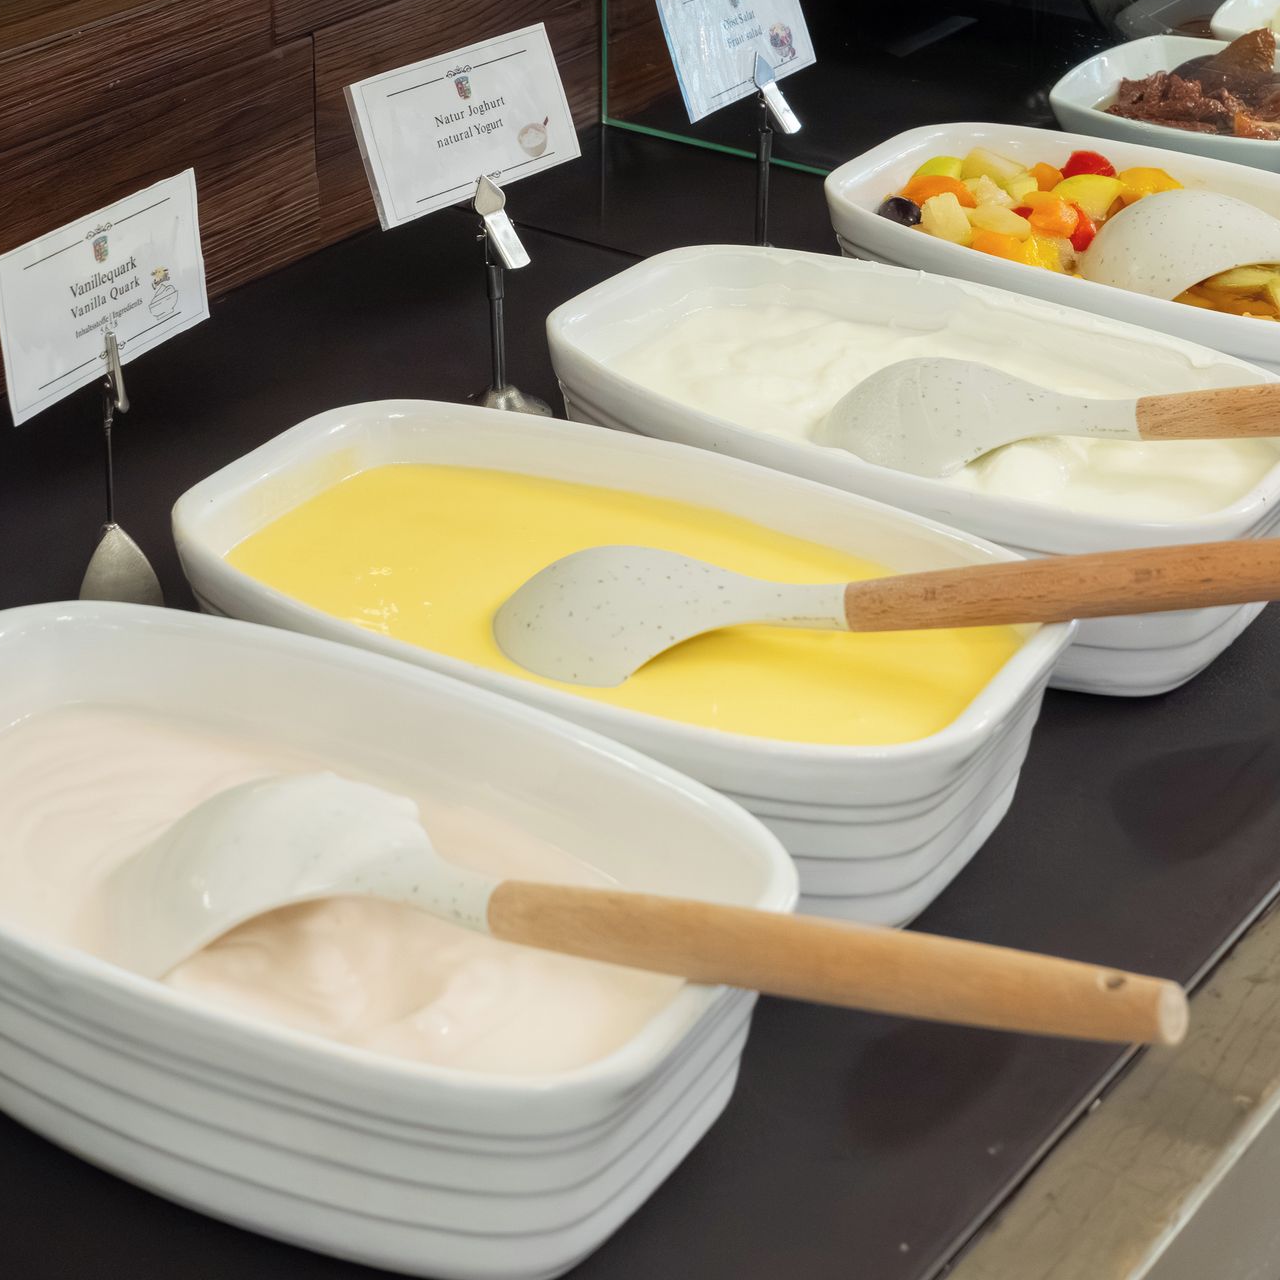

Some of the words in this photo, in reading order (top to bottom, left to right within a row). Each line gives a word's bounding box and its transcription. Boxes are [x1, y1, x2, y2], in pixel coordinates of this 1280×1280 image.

[738, 10, 755, 24] Salat
[727, 34, 744, 48] Fruit
[746, 24, 762, 40] salad
[434, 111, 464, 127] Natur
[468, 96, 505, 116] Joghurt
[437, 126, 473, 148] natural
[474, 119, 504, 134] Yogurt
[70, 256, 137, 298] Vanillequark
[70, 295, 107, 318] Vanilla
[110, 276, 140, 300] Quark
[113, 298, 143, 319] Ingredients
